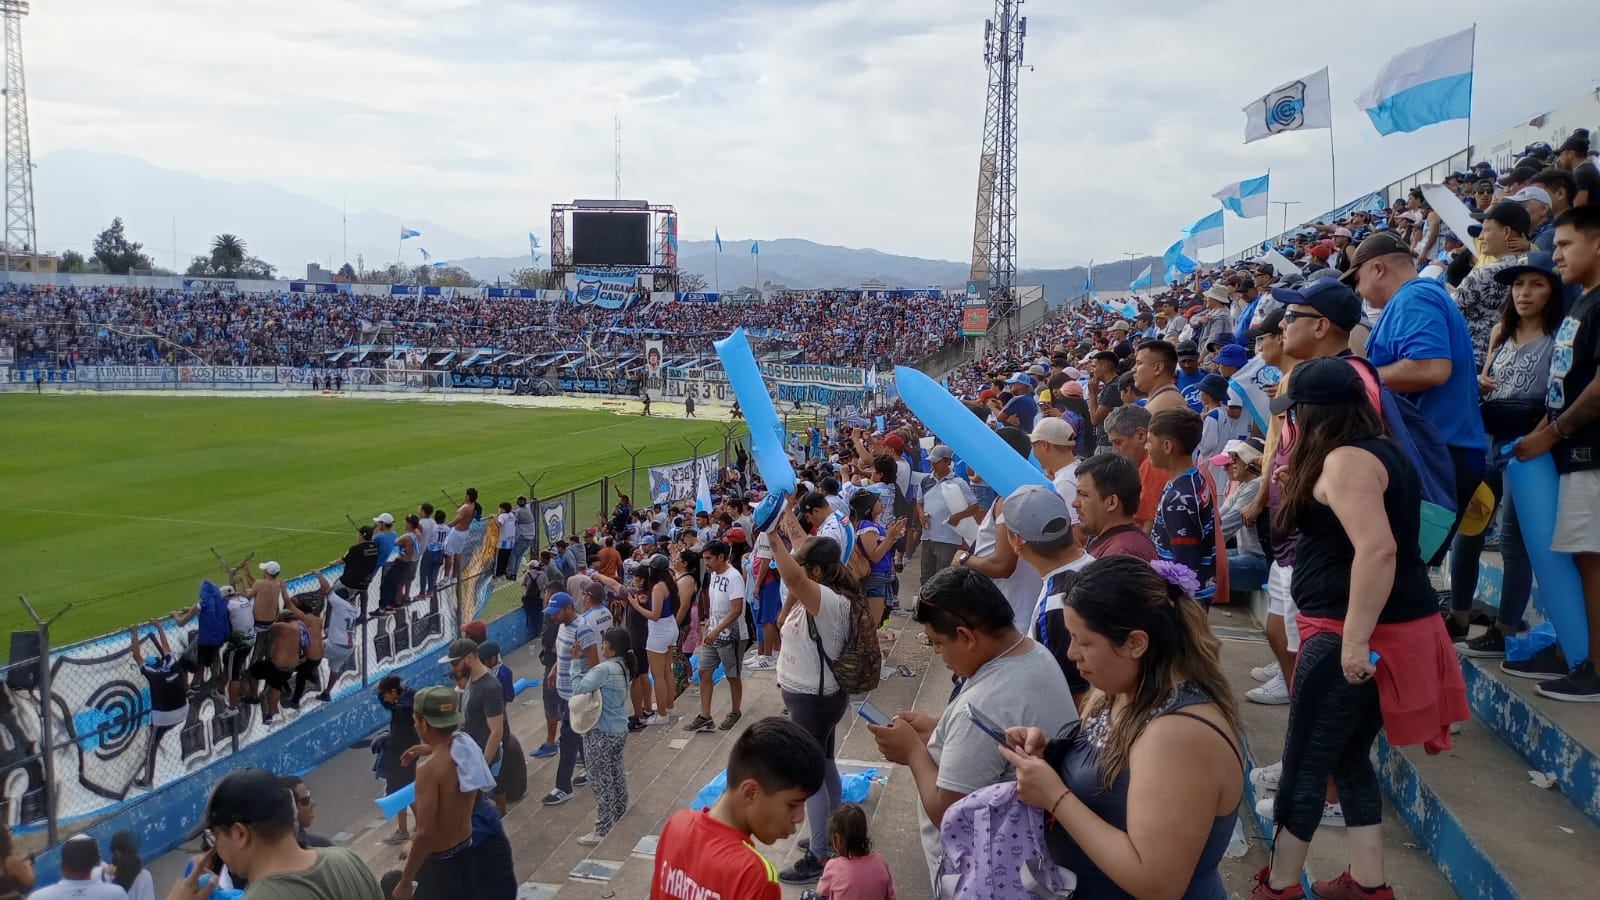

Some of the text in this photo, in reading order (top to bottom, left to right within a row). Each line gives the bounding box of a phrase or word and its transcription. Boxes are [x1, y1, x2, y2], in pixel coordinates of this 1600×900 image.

[600, 292, 625, 301] CASO
[212, 368, 242, 379] PIBES
[452, 375, 495, 387] LOS
